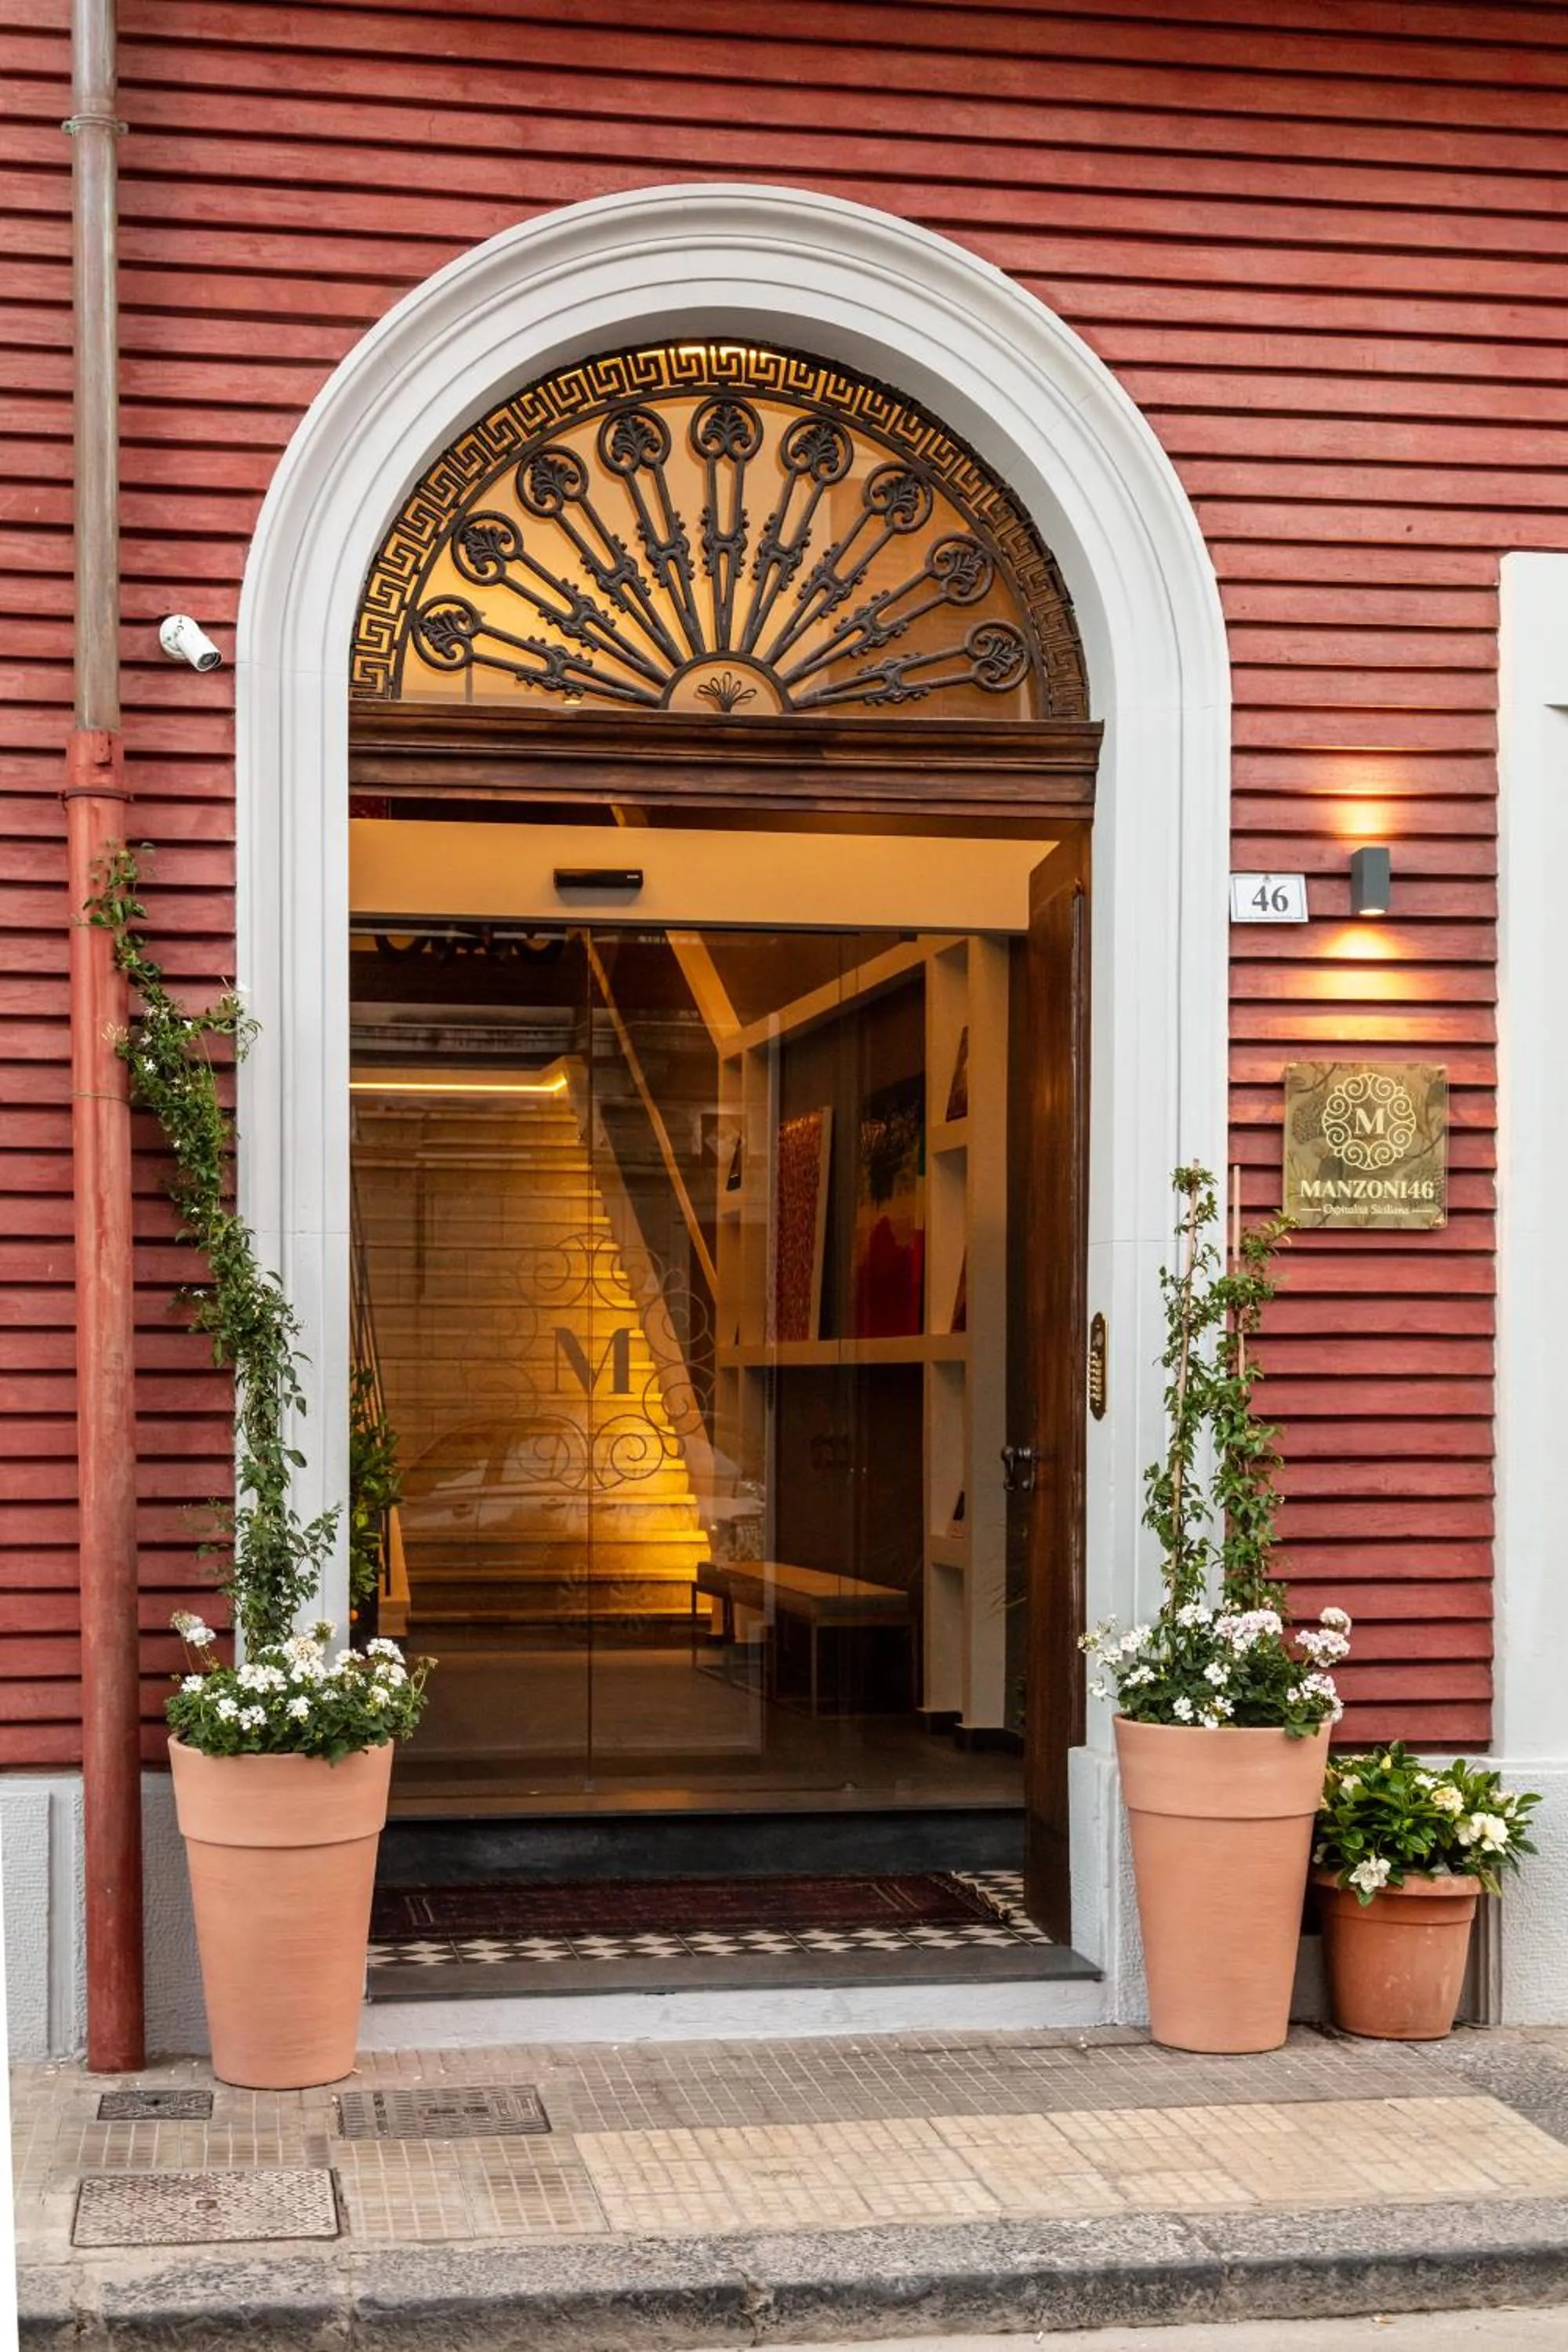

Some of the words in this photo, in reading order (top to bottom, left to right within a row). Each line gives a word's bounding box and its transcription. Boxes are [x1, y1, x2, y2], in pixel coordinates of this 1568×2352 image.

[1252, 885, 1288, 912] 46
[1354, 1108, 1386, 1134] M
[1301, 1180, 1435, 1199] MANZONI46
[551, 1327, 636, 1394] M
